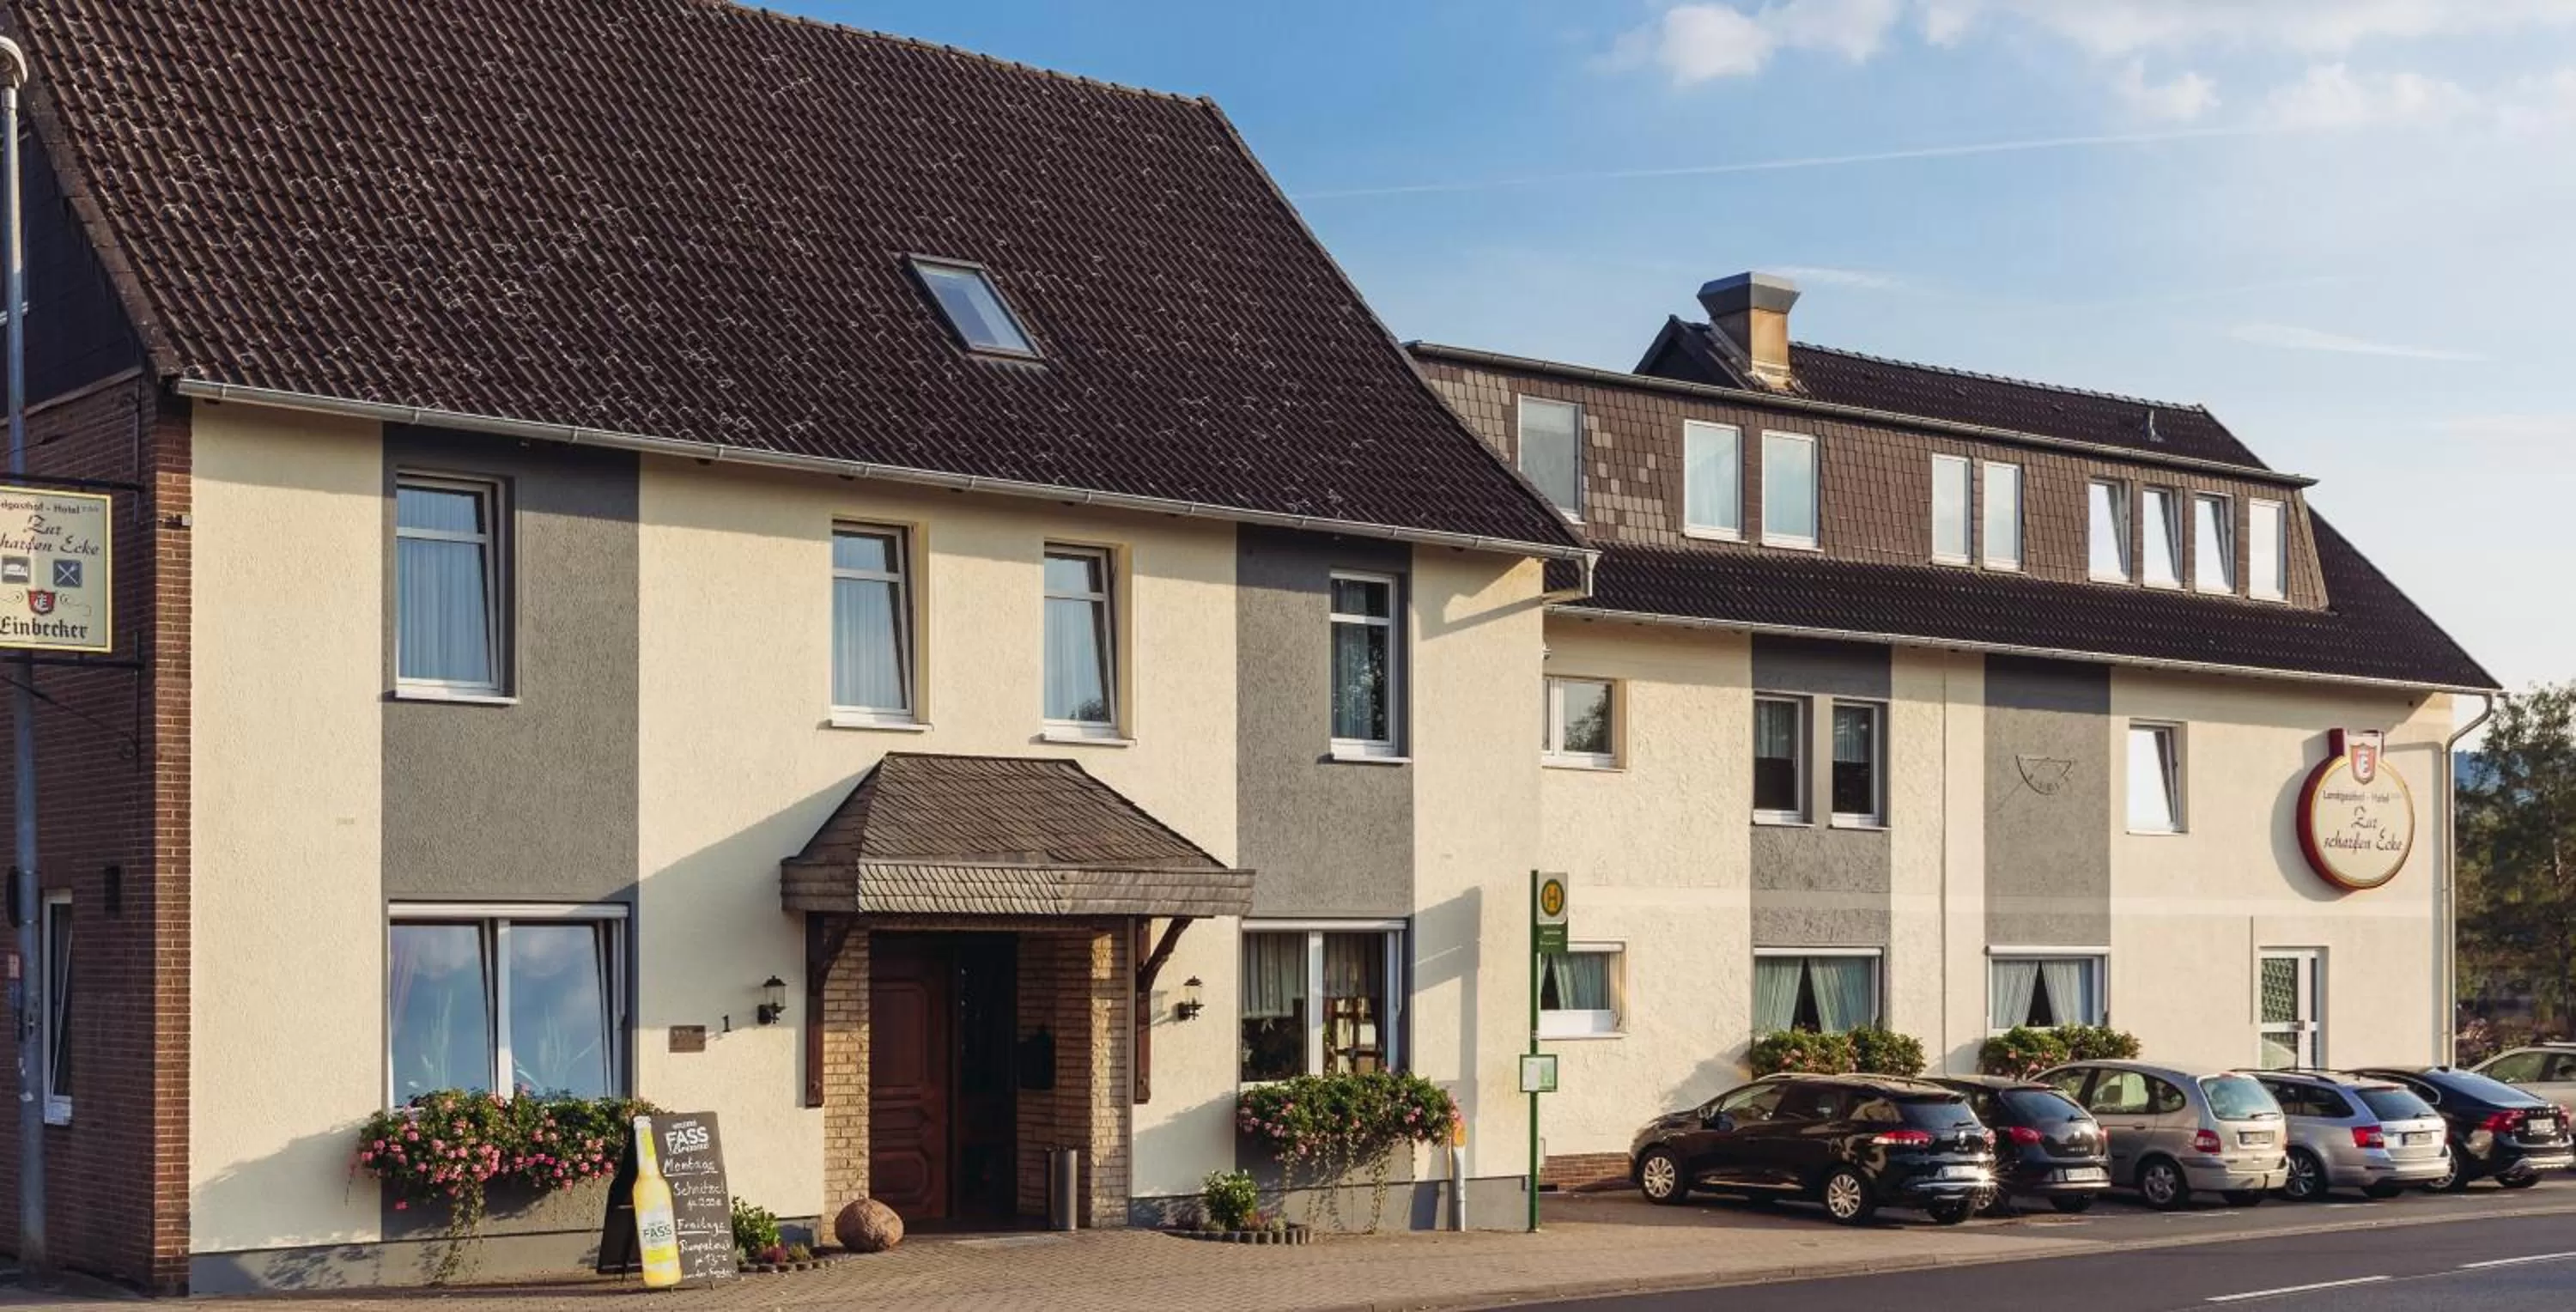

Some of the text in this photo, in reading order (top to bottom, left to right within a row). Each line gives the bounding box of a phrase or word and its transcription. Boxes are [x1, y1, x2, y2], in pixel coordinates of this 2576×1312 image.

[53, 503, 80, 514] Hotel
[22, 515, 62, 535] Zur
[59, 535, 100, 555] Ecke
[0, 616, 88, 639] Einbecker
[2351, 805, 2378, 829] Zur
[2323, 825, 2403, 855] scharfen Ecke
[722, 1015, 732, 1033] 1
[665, 1126, 709, 1151] FASS
[643, 1224, 672, 1237] FASS
